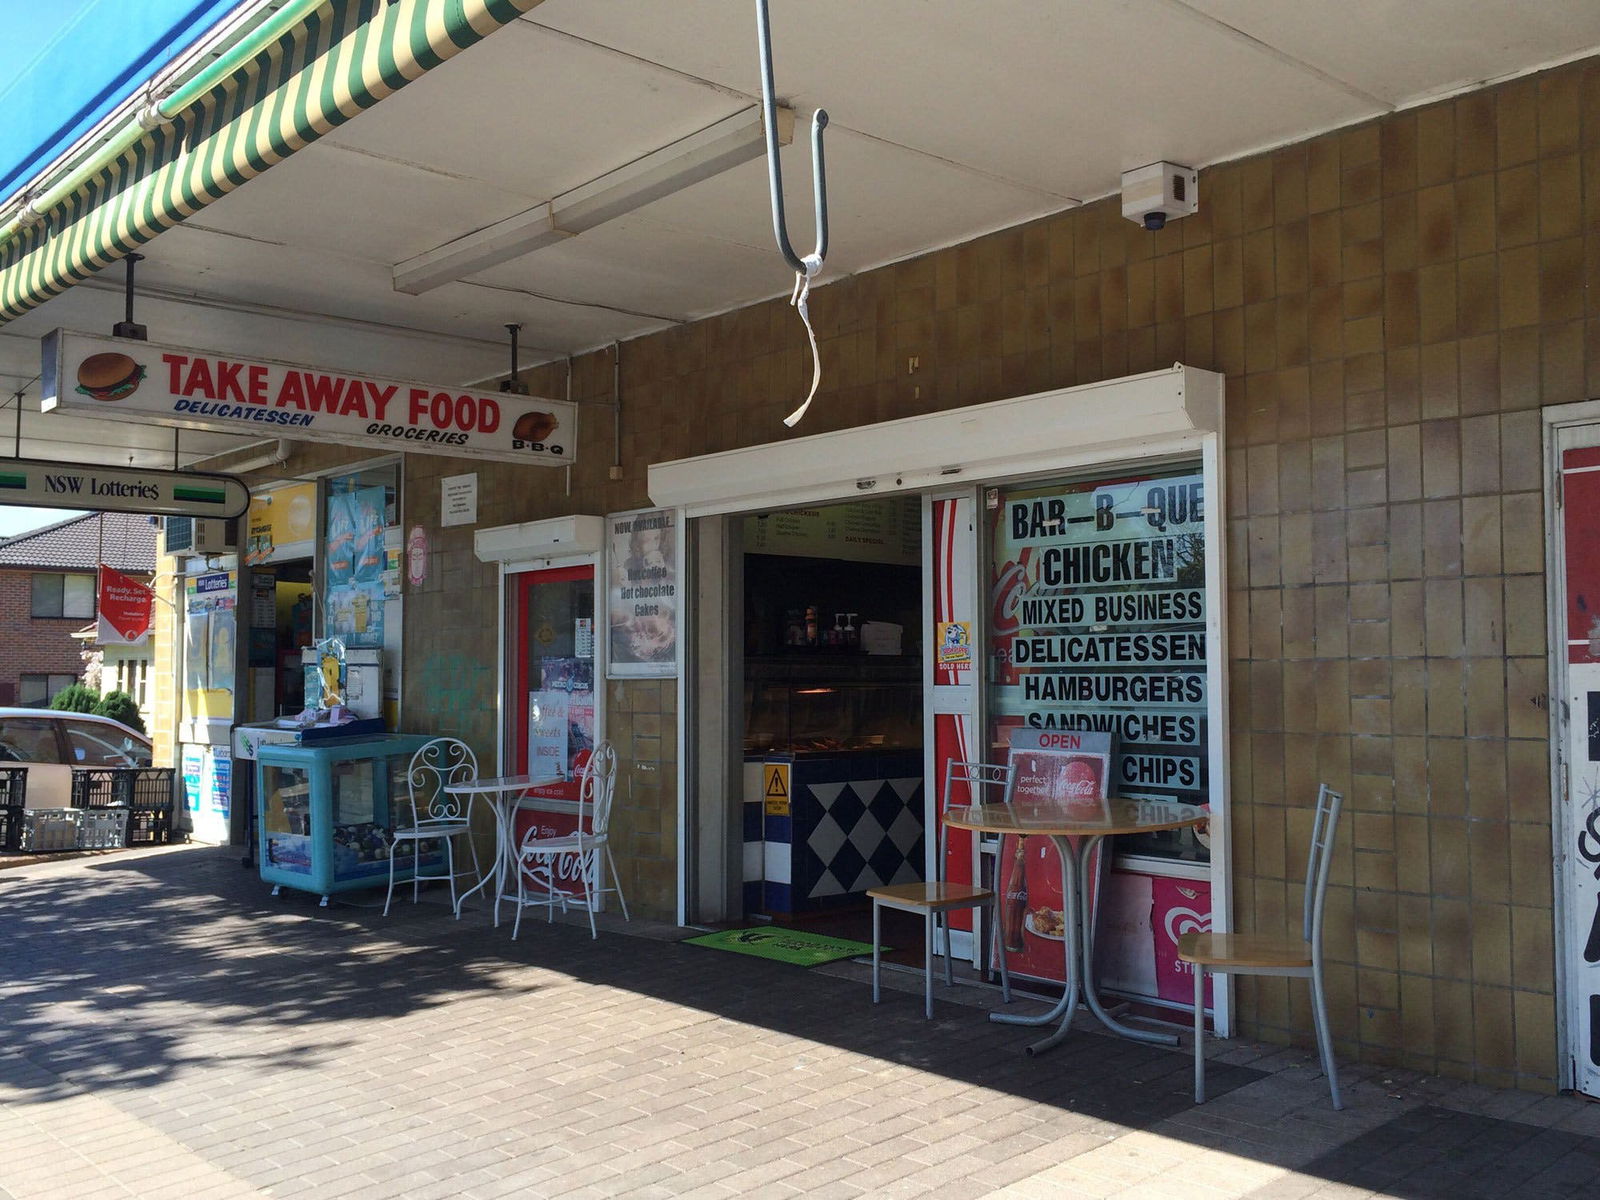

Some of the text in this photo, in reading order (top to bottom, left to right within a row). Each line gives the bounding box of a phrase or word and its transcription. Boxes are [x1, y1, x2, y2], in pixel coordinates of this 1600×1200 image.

[162, 353, 500, 434] TAKE AWAY FOOD
[174, 399, 314, 427] DELICATESSEN
[366, 423, 469, 446] GROCERIES
[44, 474, 160, 500] NSW Lotteries
[615, 521, 631, 535] NOW
[1043, 539, 1174, 586] CHICKEN
[205, 576, 227, 590] Lotteries
[621, 584, 675, 599] Hot chocolate
[635, 604, 659, 617] Cakes
[1022, 591, 1202, 625] MIXED BUSINESS
[1015, 634, 1206, 663] DELICATESSEN
[1024, 675, 1203, 703] HAMBURGERS
[1028, 712, 1196, 743] SANDWICHES
[1039, 734, 1081, 749] OPEN
[1020, 775, 1047, 787] perfect
[1122, 756, 1195, 785] CHIPS
[541, 825, 557, 837] Enjoy
